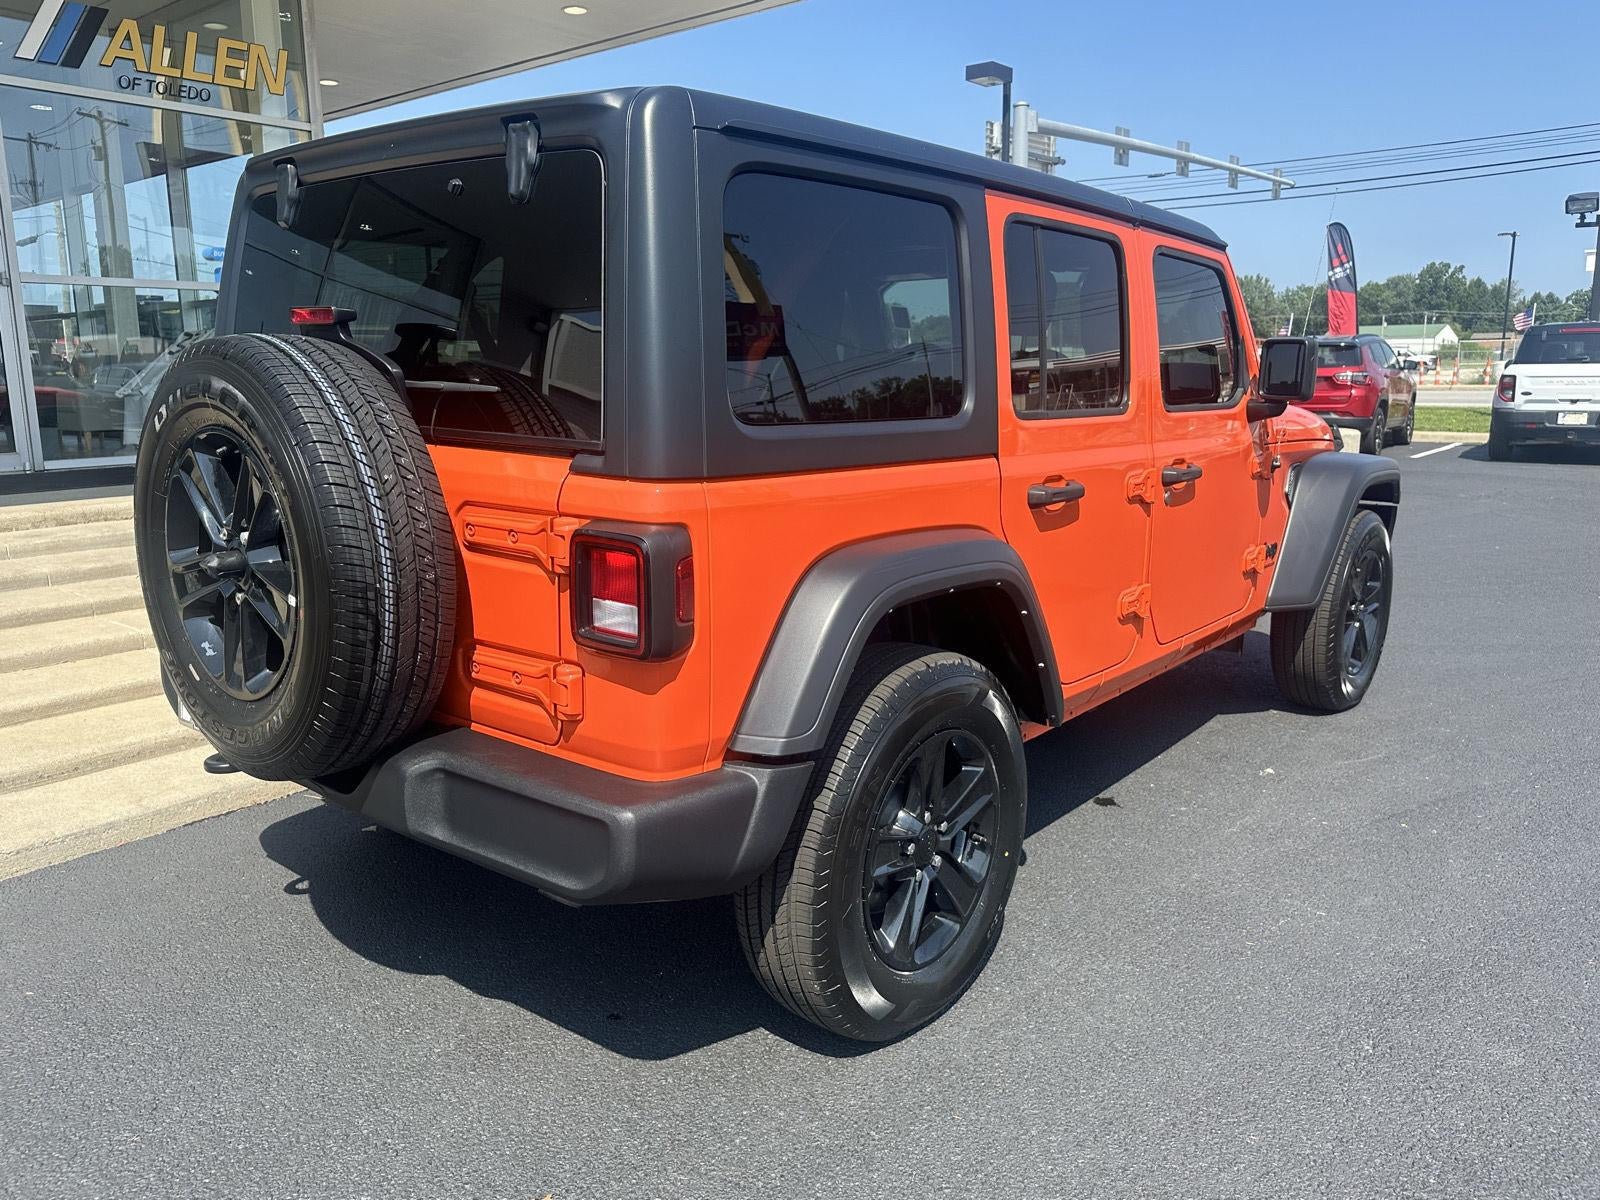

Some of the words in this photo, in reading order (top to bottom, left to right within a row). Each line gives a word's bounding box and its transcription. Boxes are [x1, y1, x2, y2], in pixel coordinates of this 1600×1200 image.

[100, 18, 289, 96] ALLEN
[118, 74, 142, 91] OF
[146, 79, 211, 102] TOLEDO
